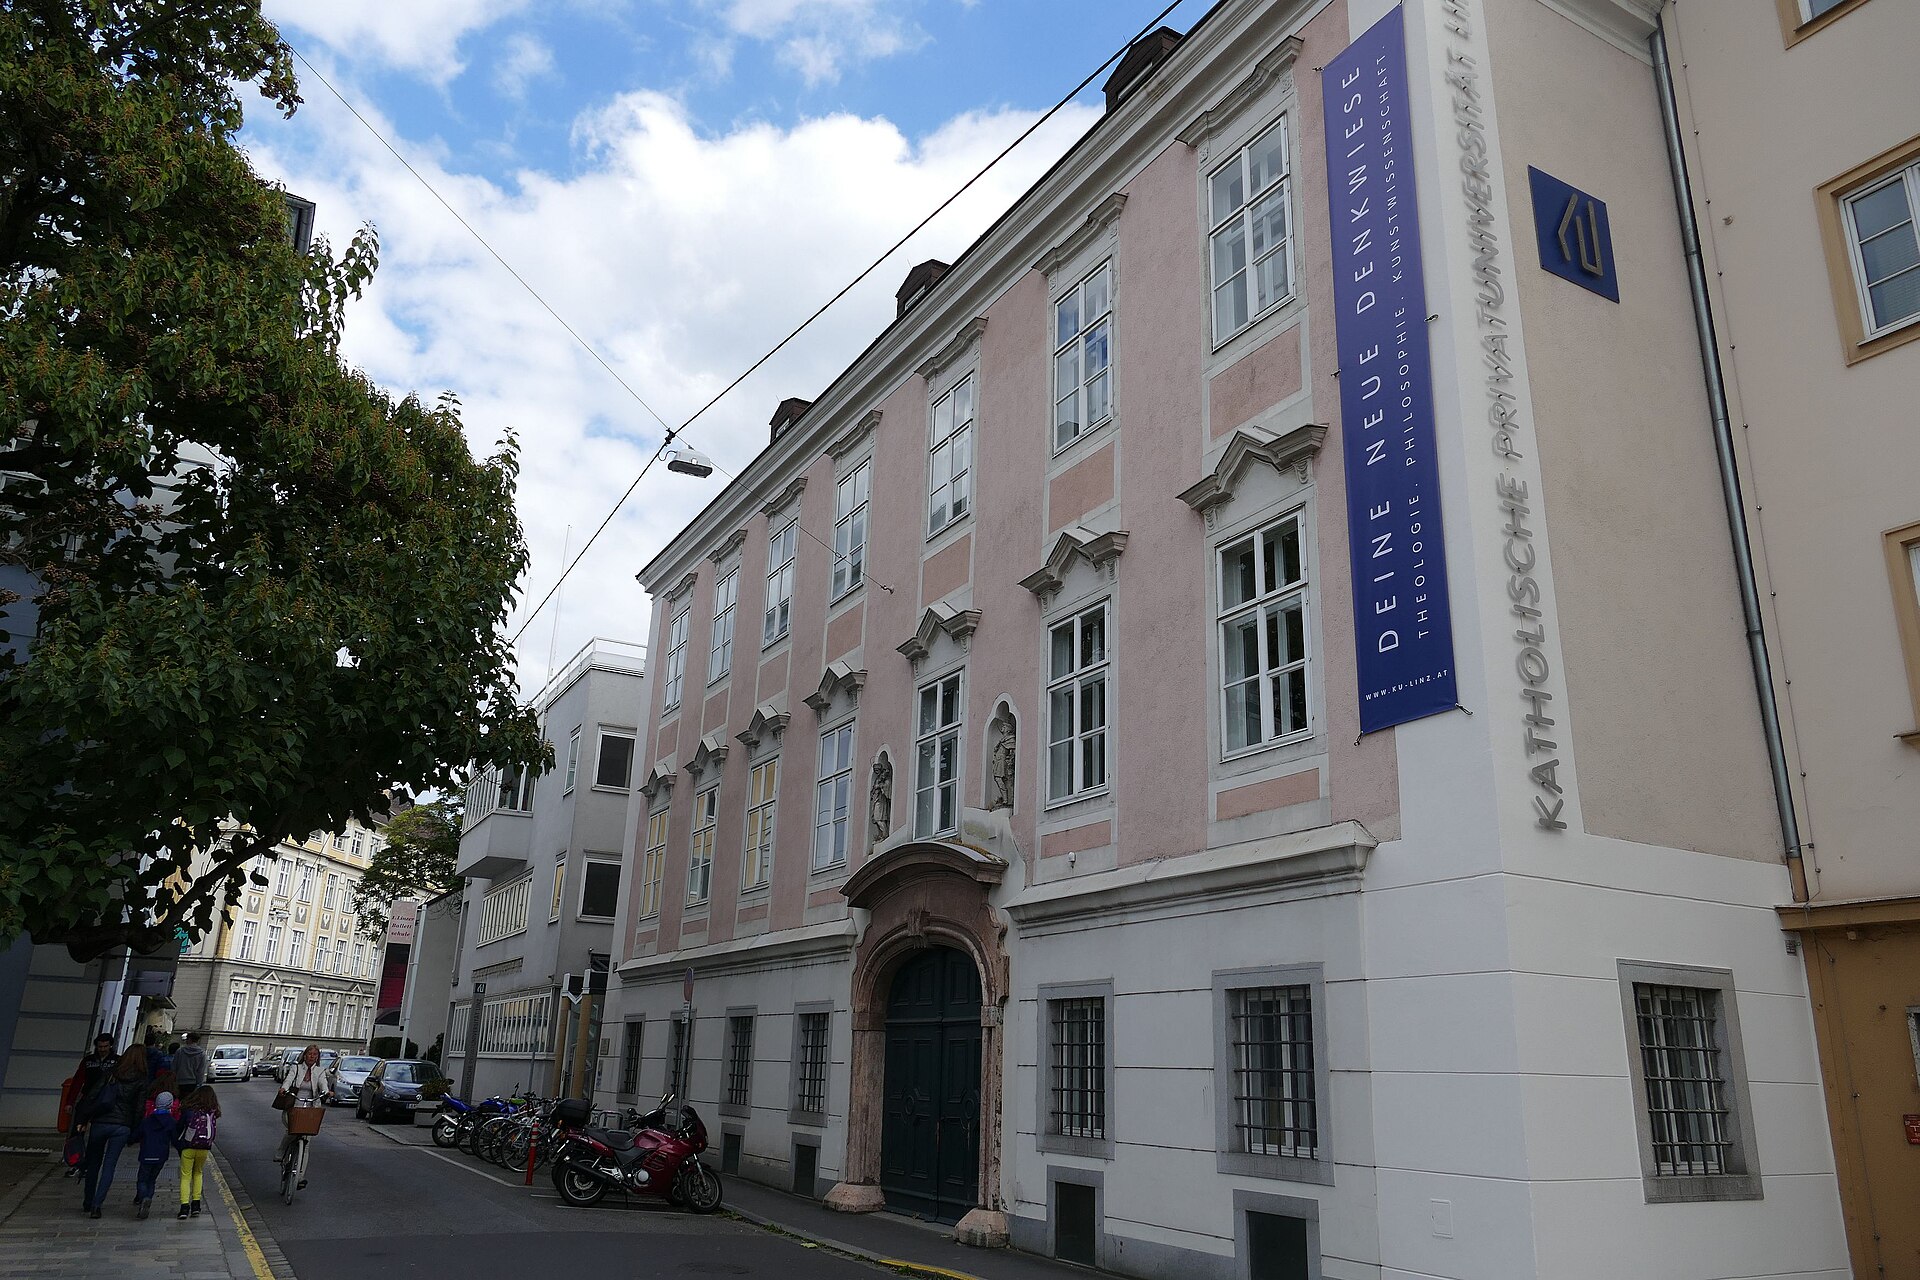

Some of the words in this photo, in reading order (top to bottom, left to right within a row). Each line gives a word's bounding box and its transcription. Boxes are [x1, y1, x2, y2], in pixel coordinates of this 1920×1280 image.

[1342, 66, 1377, 315] DENKWIESE
[1448, 44, 1523, 458] PRIVATUNIVERSITÄT
[1359, 344, 1387, 466] NEUE
[1370, 499, 1399, 653] DEINE
[1501, 472, 1568, 830] KATHOLISCHE
[1365, 669, 1449, 700] WWW.KU-LINZ.AT
